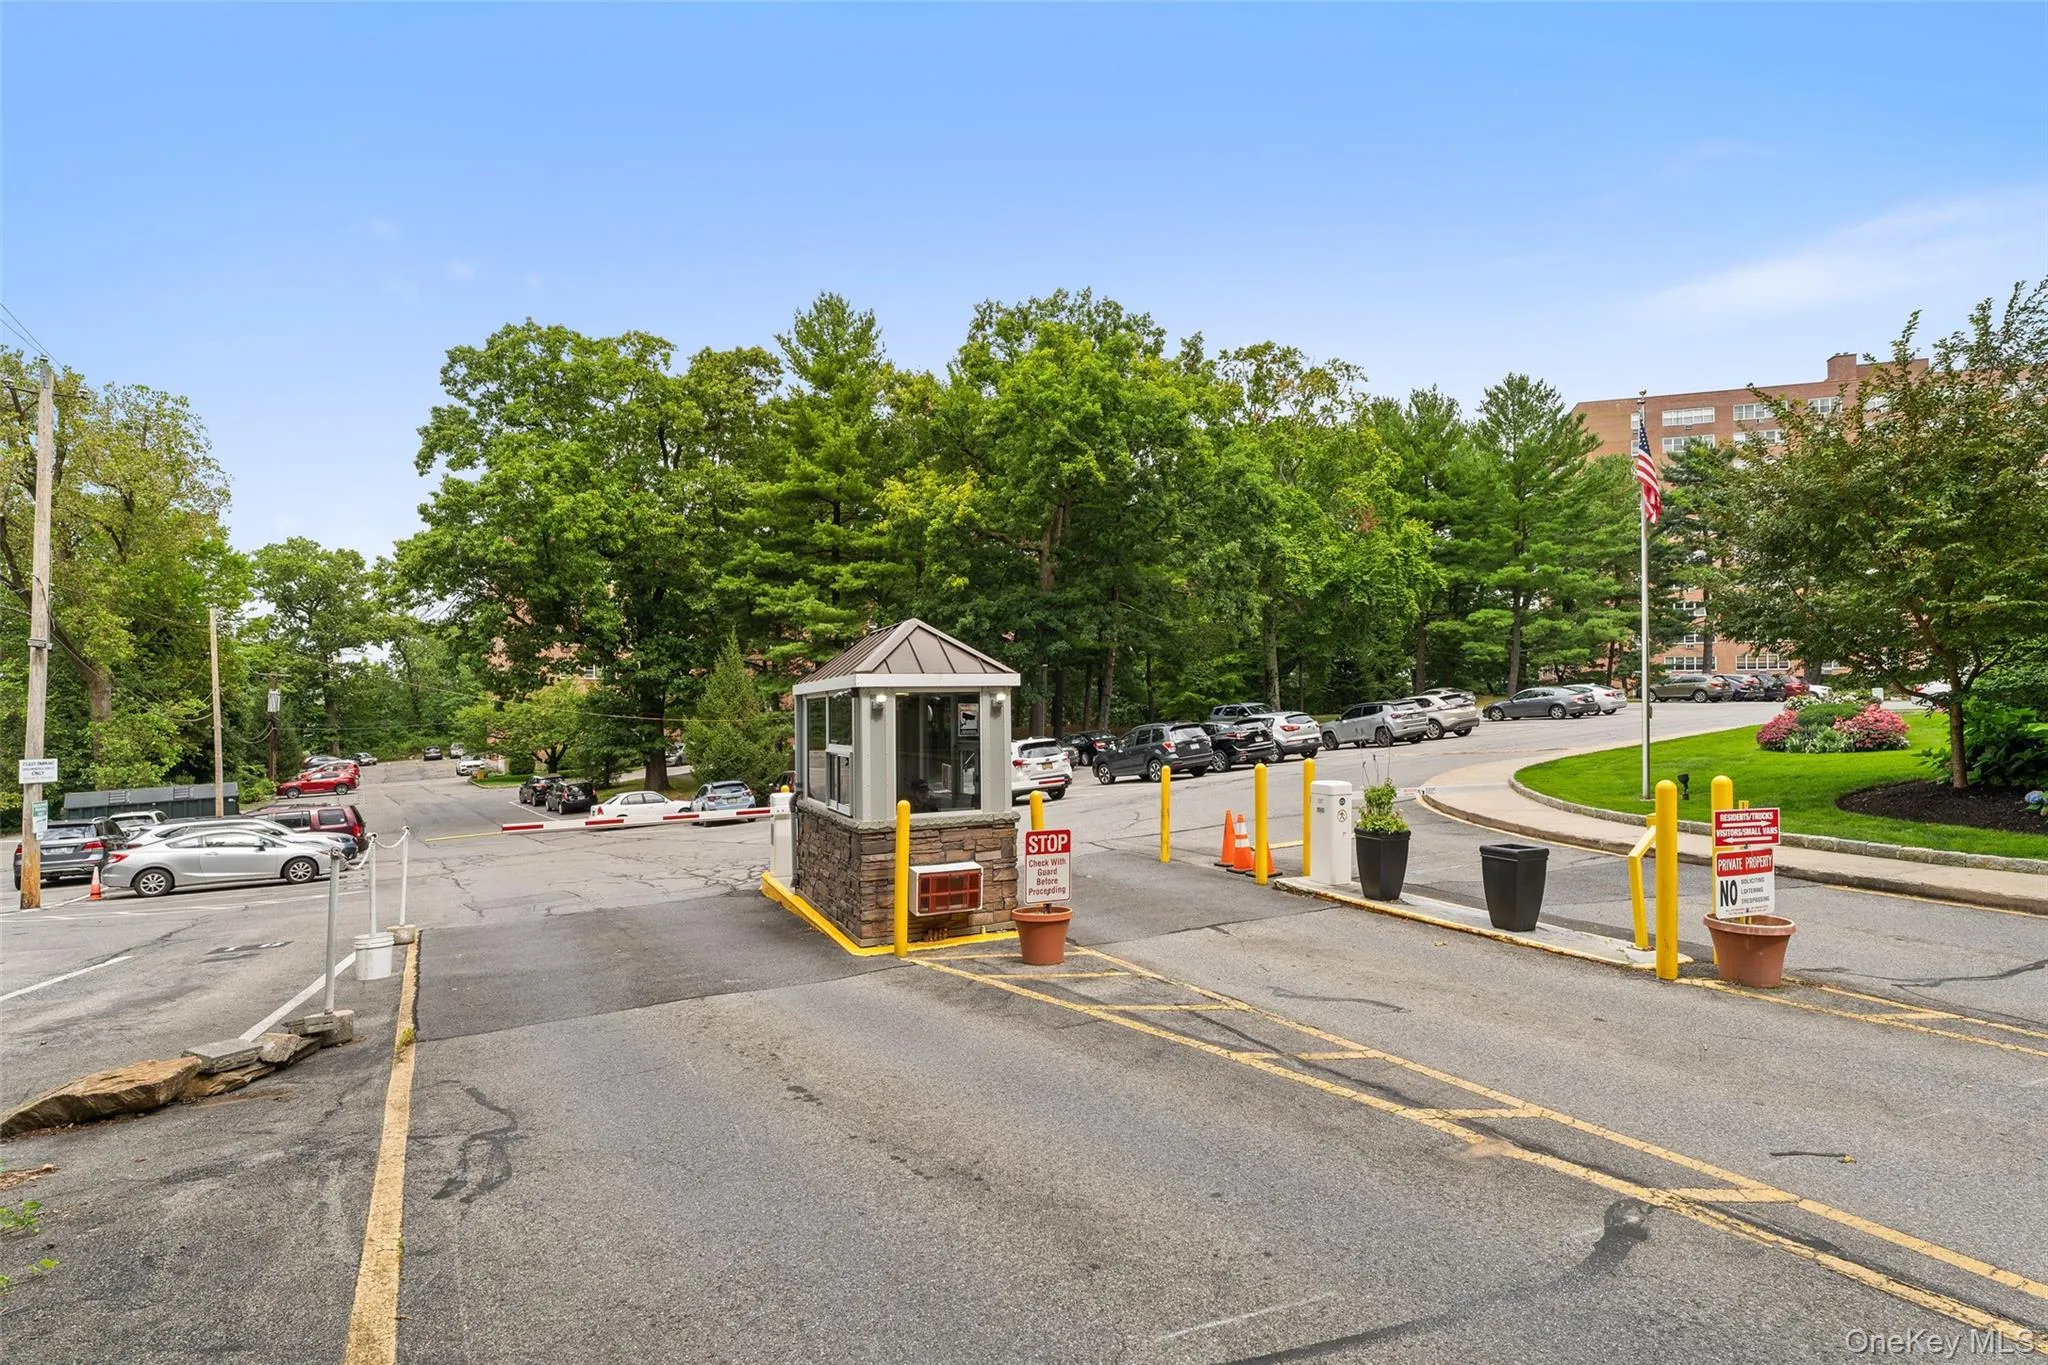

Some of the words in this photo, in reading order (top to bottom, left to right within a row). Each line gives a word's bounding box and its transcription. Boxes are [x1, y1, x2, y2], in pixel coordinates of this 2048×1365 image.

[1762, 827, 1778, 835] VANS
[1028, 834, 1068, 853] STOP
[1029, 860, 1049, 868] Check
[1051, 858, 1066, 866] With
[1718, 858, 1743, 871] PRIVATE
[1745, 854, 1773, 870] PROPERTY
[1037, 868, 1058, 877] Guard
[1036, 878, 1058, 886] Before
[1028, 886, 1066, 896] Proceeding
[1720, 880, 1738, 906] NO
[1741, 896, 1770, 904] TRESPASSING
